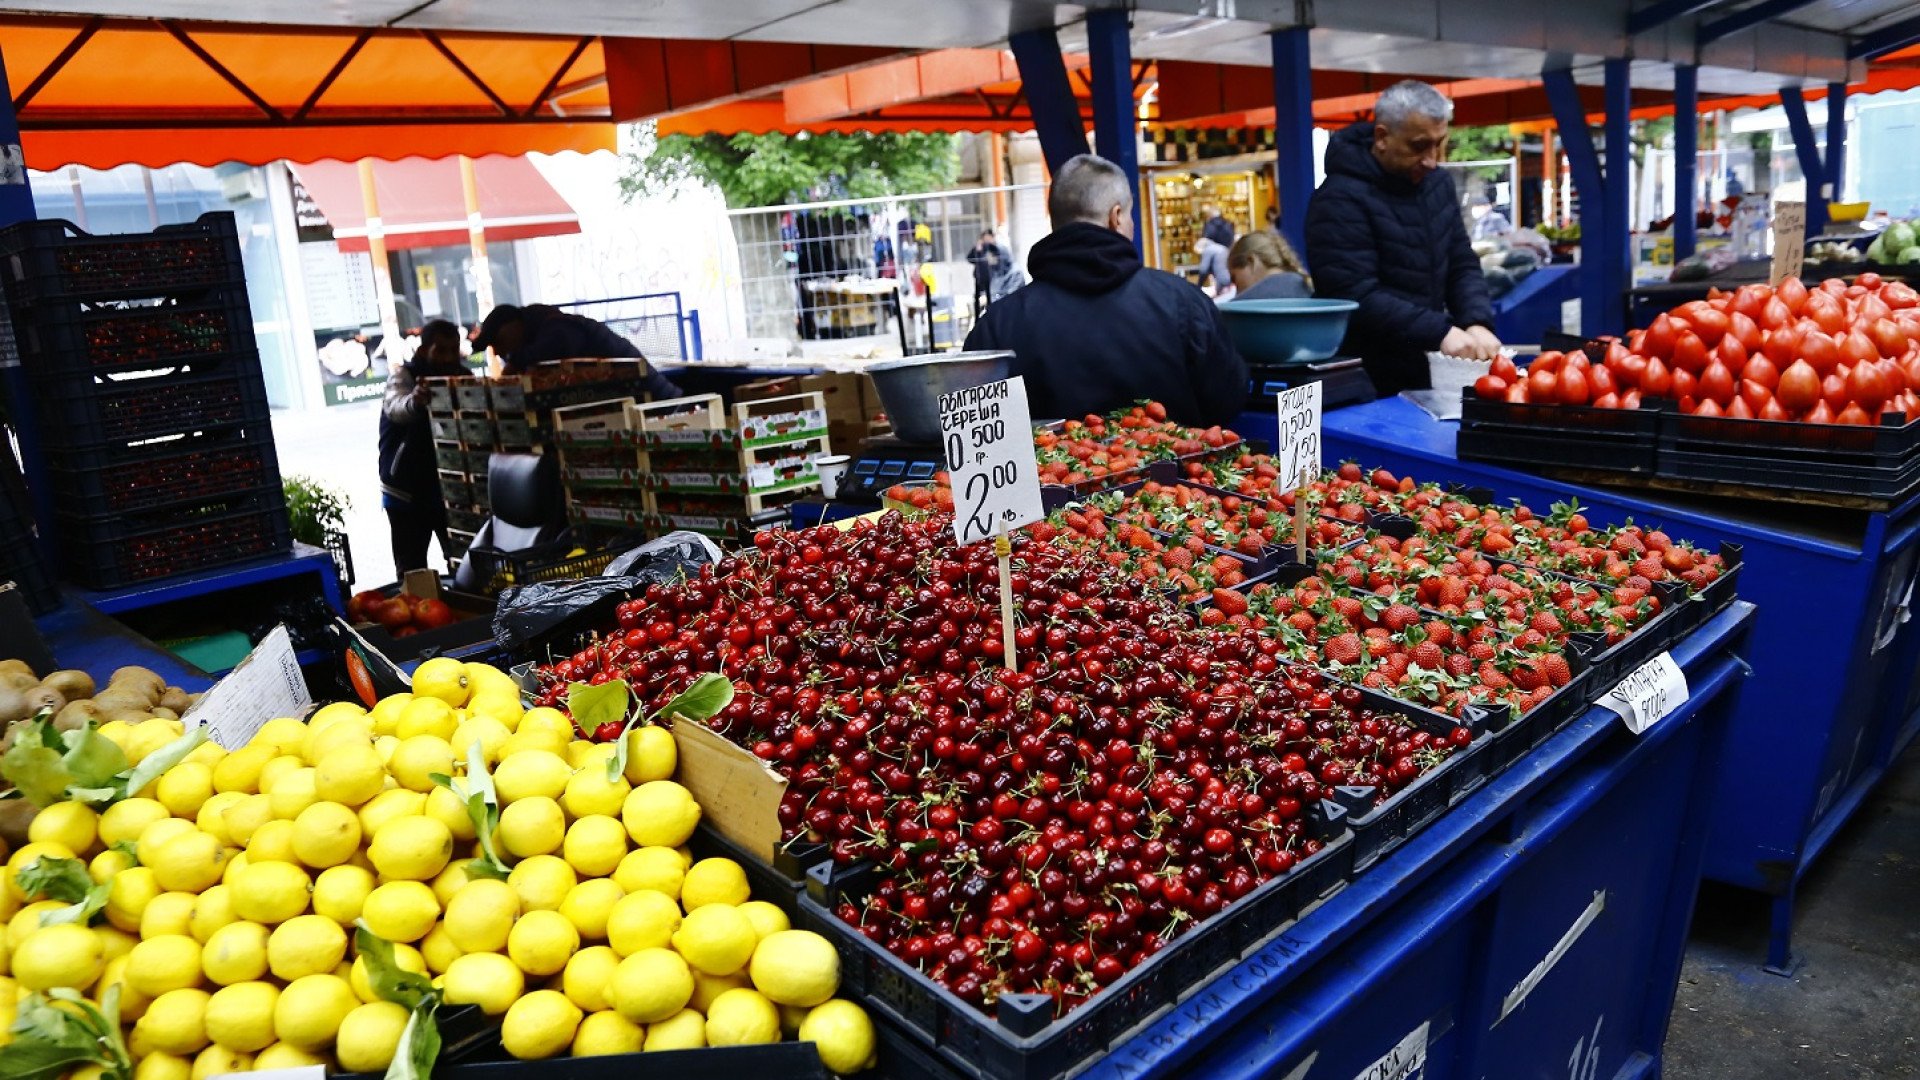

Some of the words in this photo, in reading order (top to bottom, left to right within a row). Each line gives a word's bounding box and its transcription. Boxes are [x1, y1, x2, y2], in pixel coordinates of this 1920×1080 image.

[1281, 385, 1313, 415] ЯГОДА
[941, 402, 1000, 431] ЧЕРЕША
[972, 420, 1004, 447] 500
[963, 473, 993, 541] 2
[993, 460, 1017, 489] 00
[1232, 935, 1311, 991] СОФИЯ
